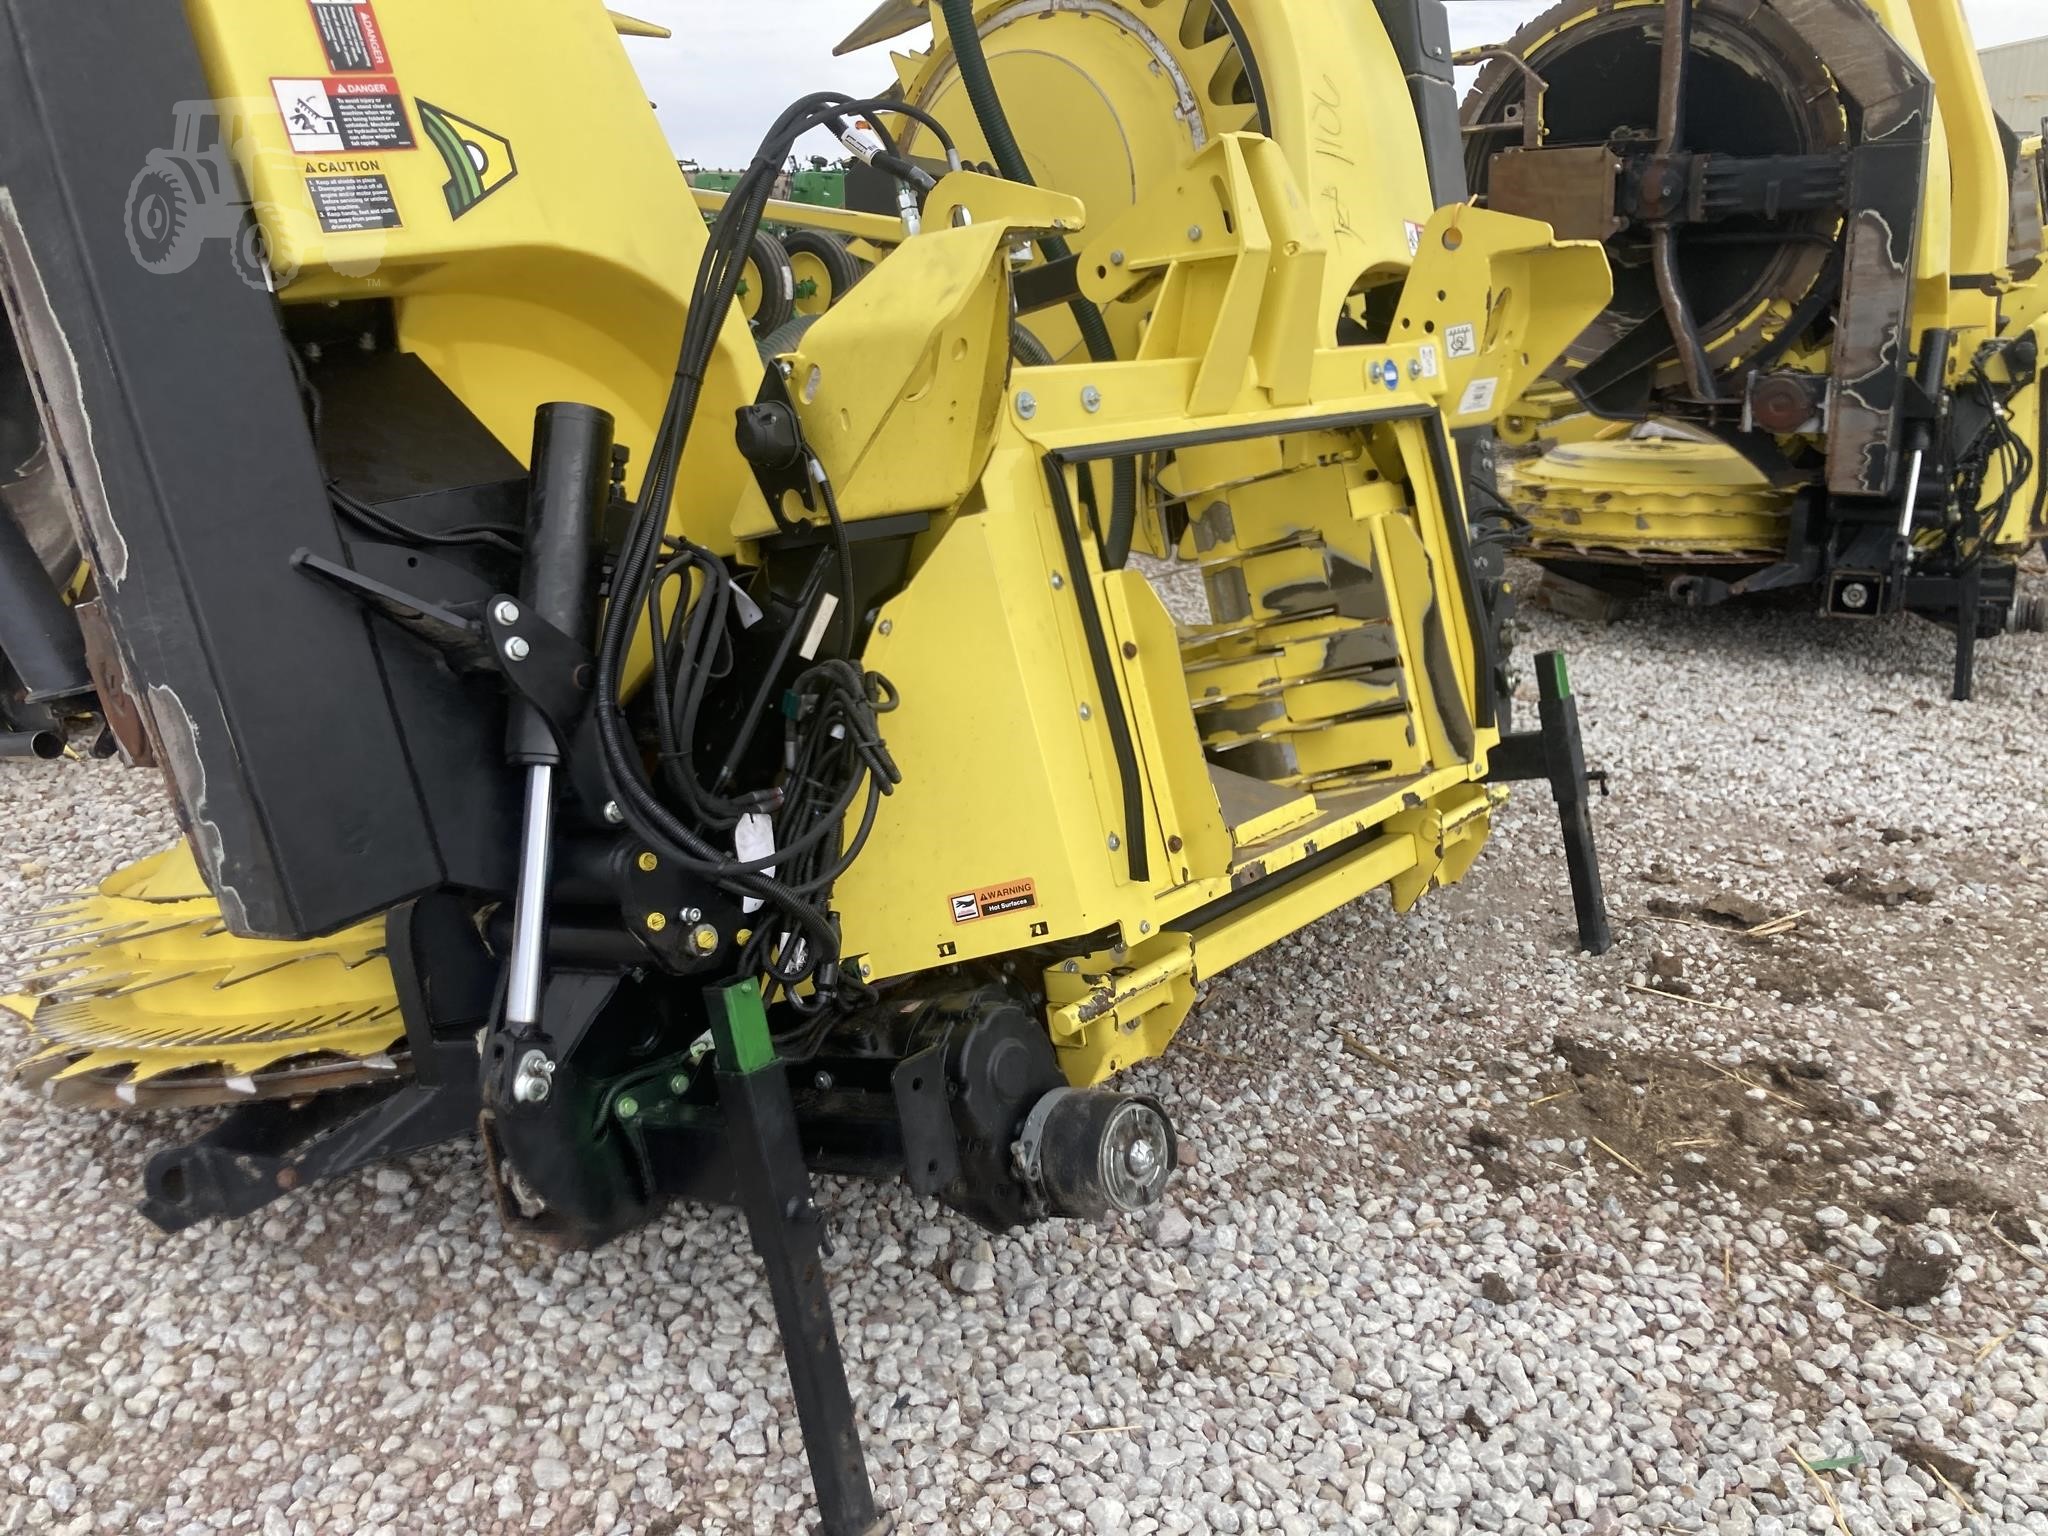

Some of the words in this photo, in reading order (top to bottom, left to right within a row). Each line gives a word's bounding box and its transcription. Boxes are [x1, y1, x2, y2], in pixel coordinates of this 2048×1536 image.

[365, 20, 384, 64] DANGER
[348, 84, 387, 93] DANGER
[318, 160, 380, 172] CAUTION
[988, 883, 1031, 900] WARNING
[989, 904, 1000, 912] Hot
[1001, 899, 1027, 909] Surfaces
